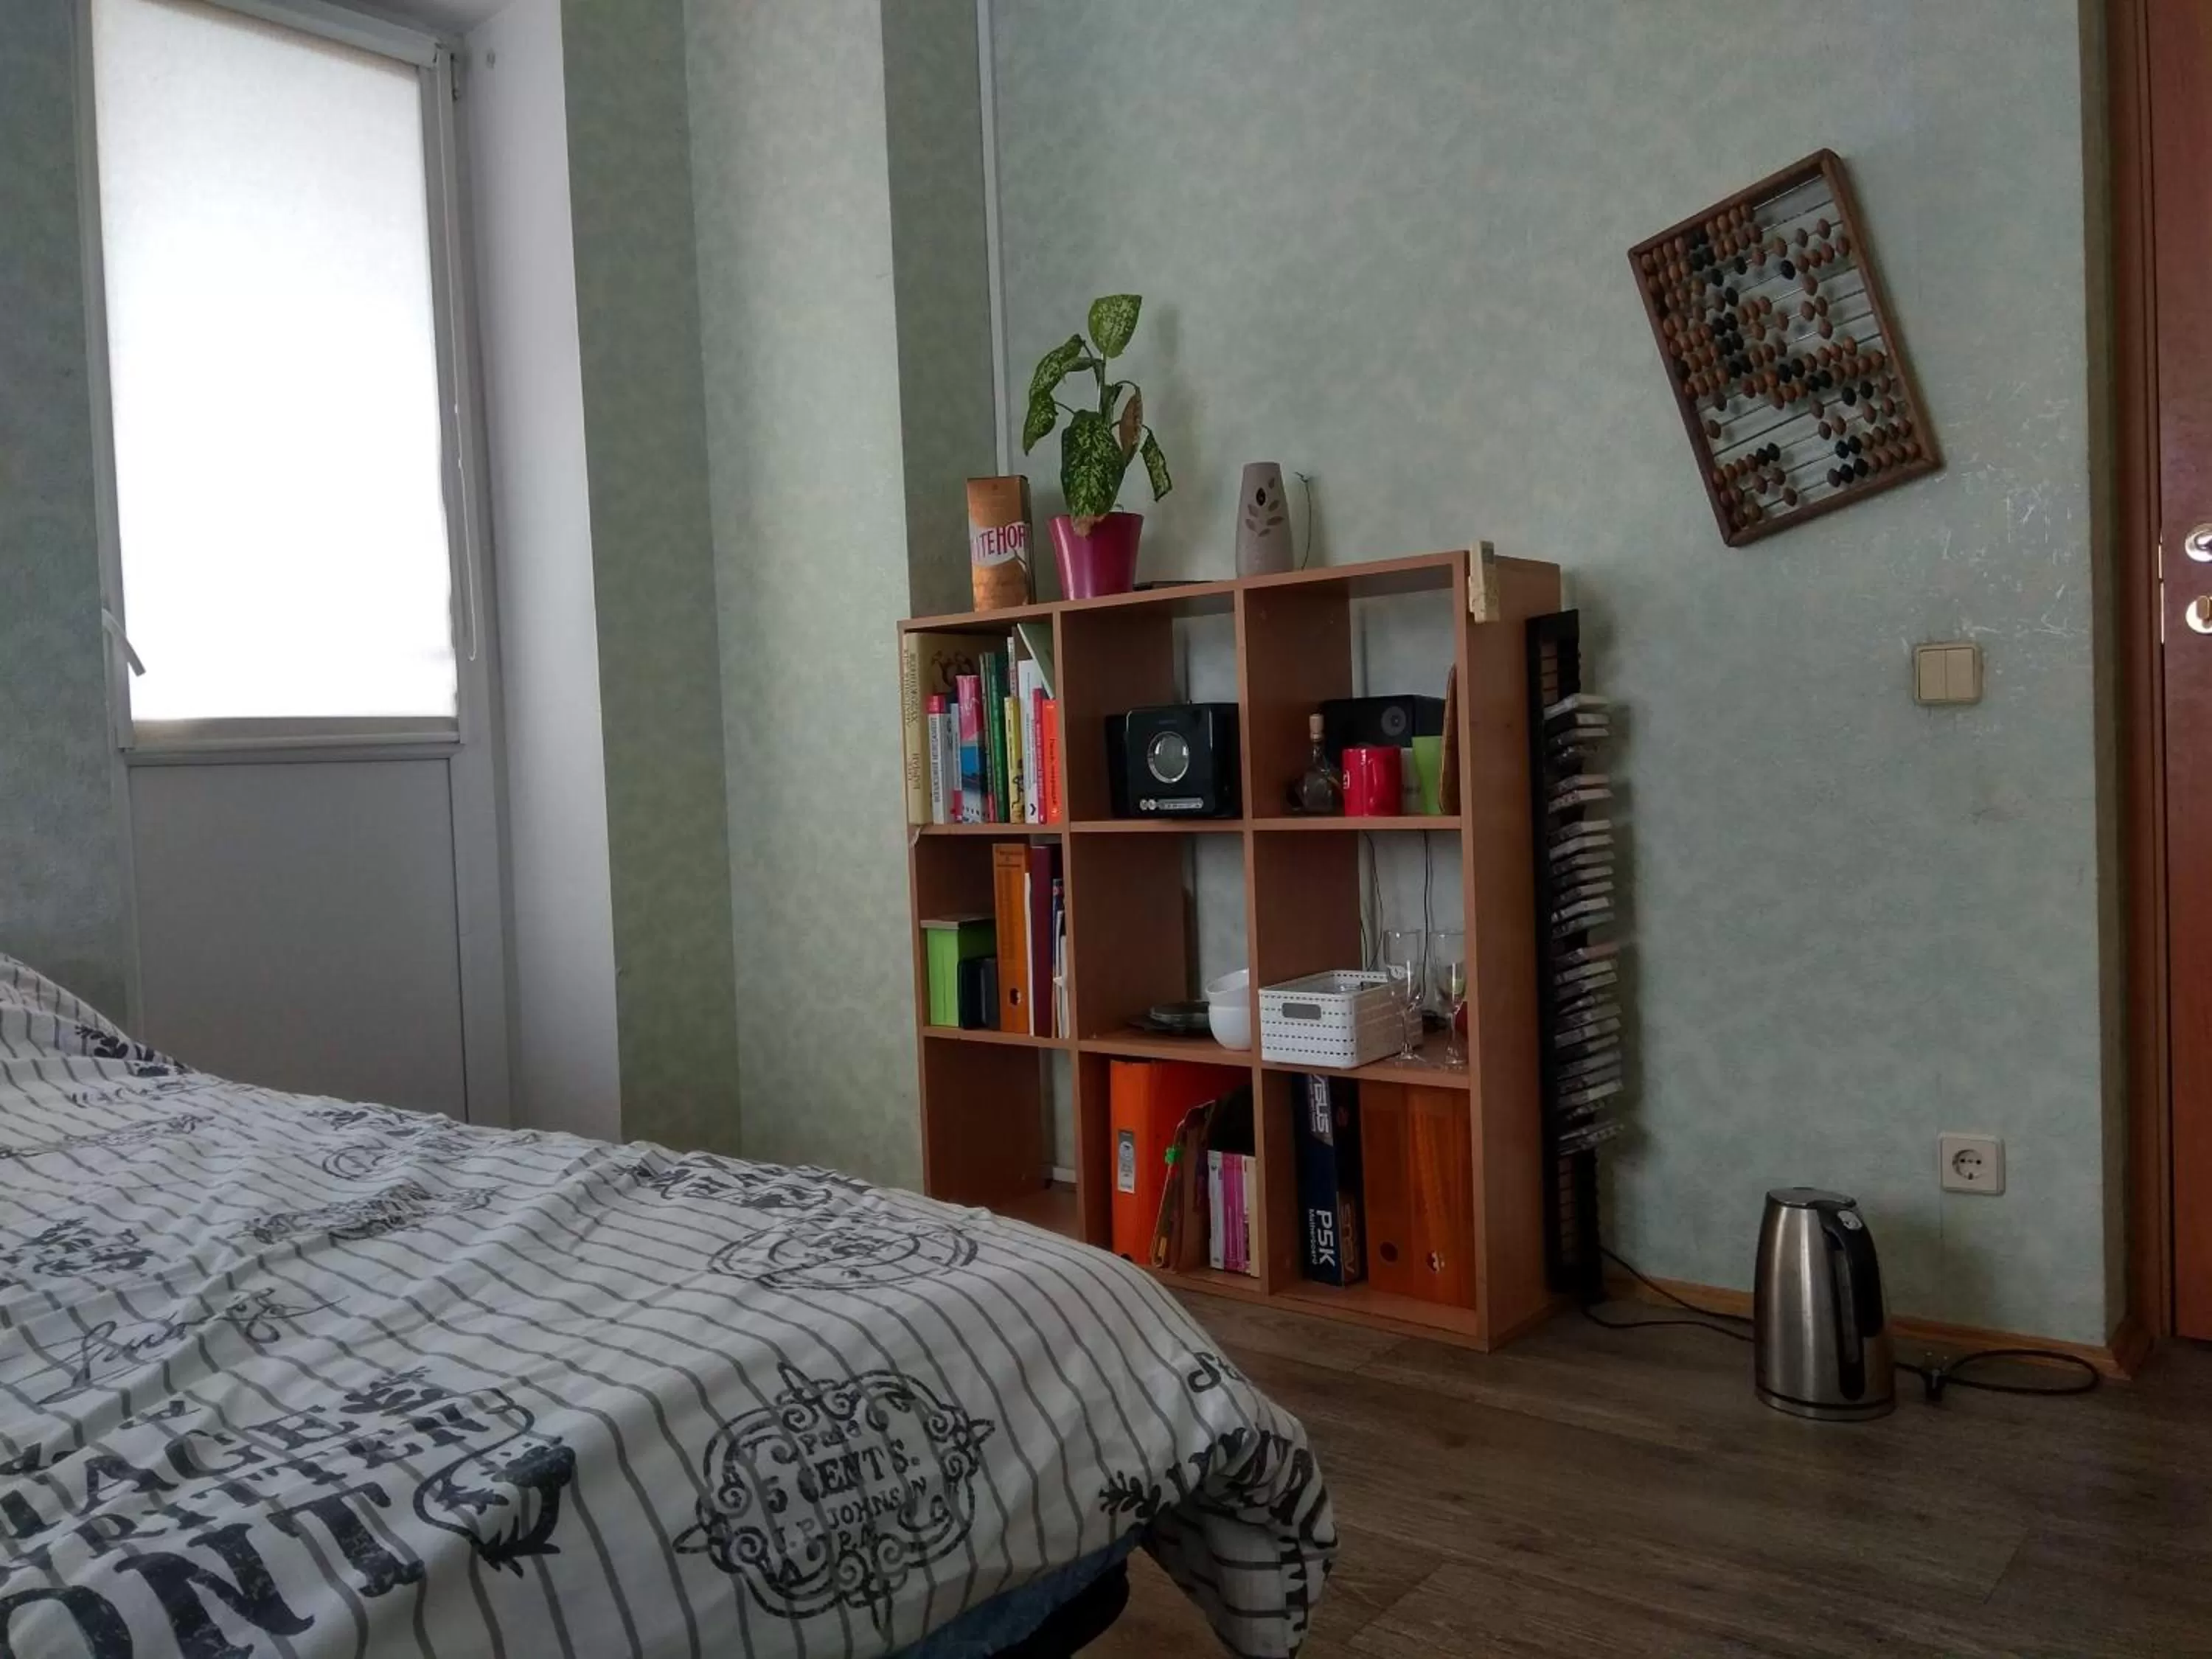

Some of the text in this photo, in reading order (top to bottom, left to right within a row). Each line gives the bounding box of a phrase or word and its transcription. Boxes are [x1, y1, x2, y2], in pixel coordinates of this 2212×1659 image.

[1313, 1074, 1329, 1134] ASUS
[1315, 1209, 1336, 1268] P5K
[766, 1475, 787, 1513] 5
[827, 1475, 927, 1530] JOHNSN
